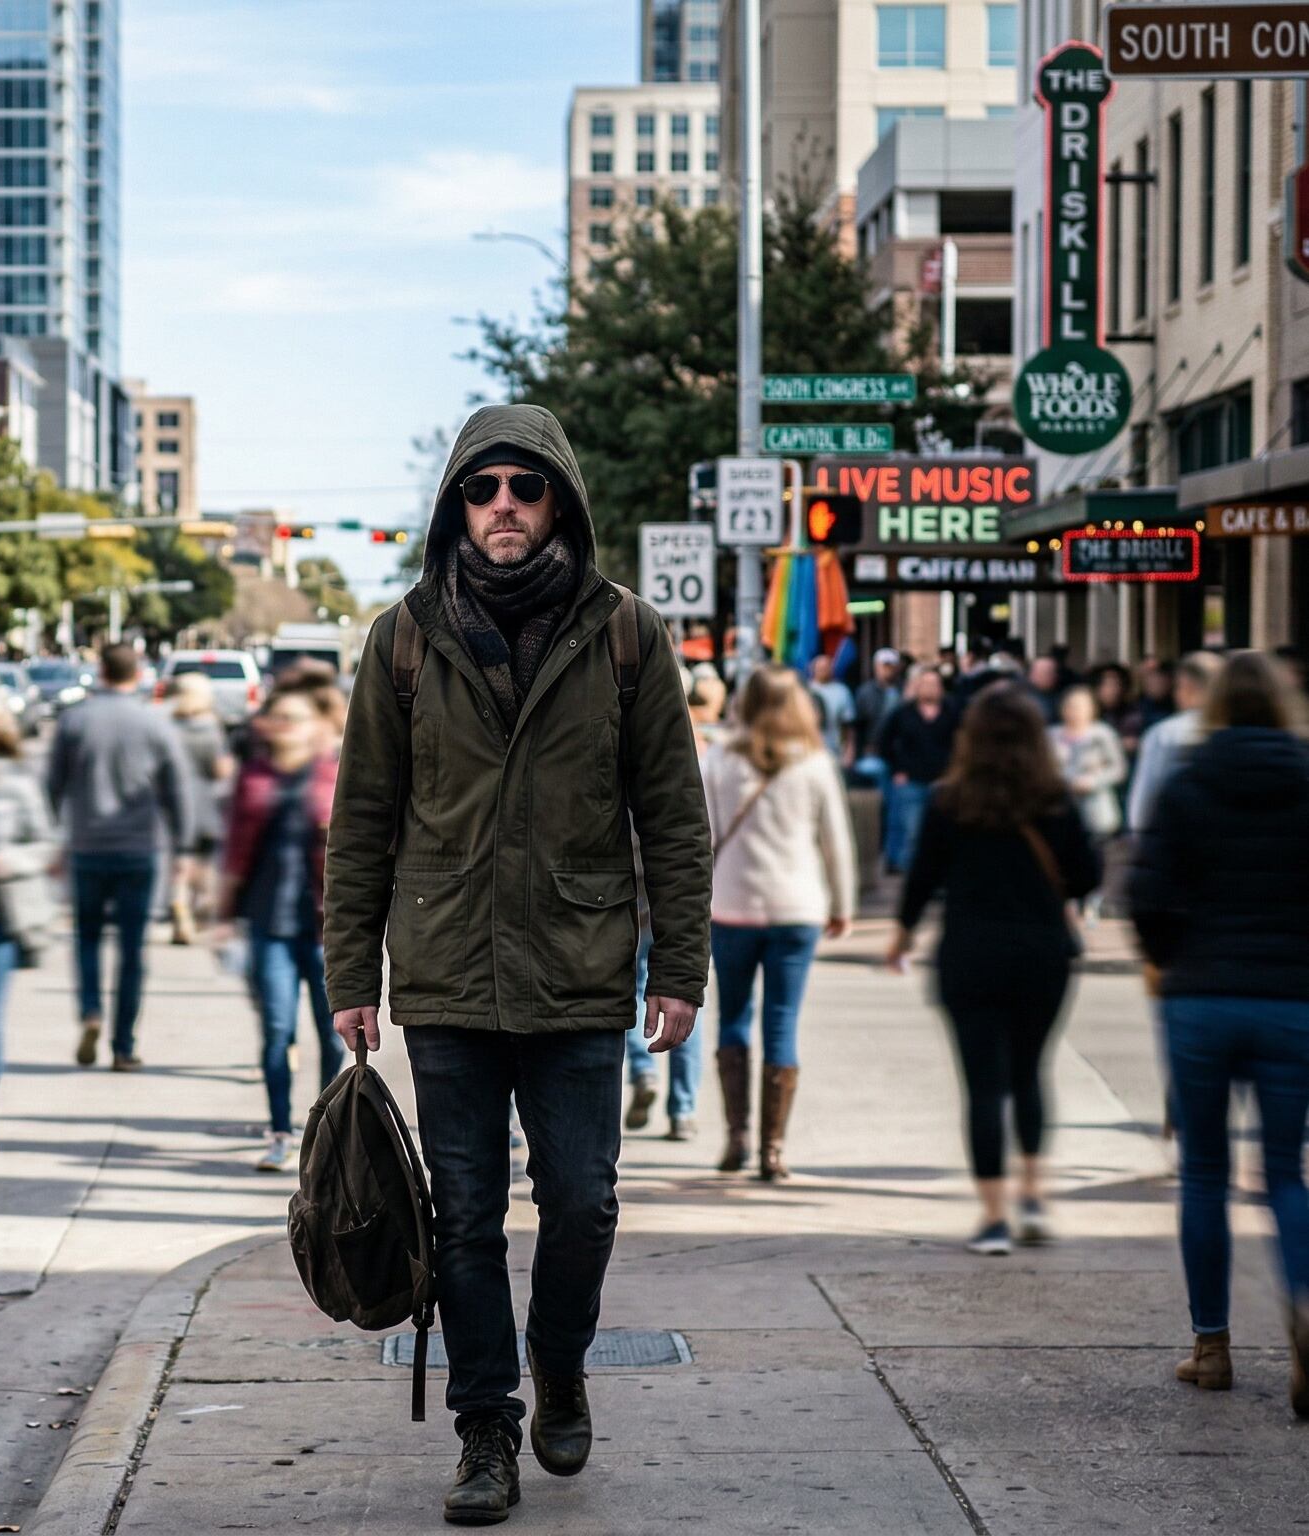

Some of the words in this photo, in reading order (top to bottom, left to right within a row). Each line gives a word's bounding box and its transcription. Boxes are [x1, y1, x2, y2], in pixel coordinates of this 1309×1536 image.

[1119, 23, 1231, 61] SOUTH
[1046, 69, 1105, 92] THE
[1059, 101, 1090, 340] DRISKILL
[765, 377, 810, 400] SOUTH
[1025, 367, 1121, 397] WHOLE
[1030, 394, 1118, 420] FOODS
[910, 466, 1031, 503] MUSIC
[878, 505, 1001, 543] HERE
[1221, 507, 1270, 533] CAFE
[653, 574, 704, 605] 30
